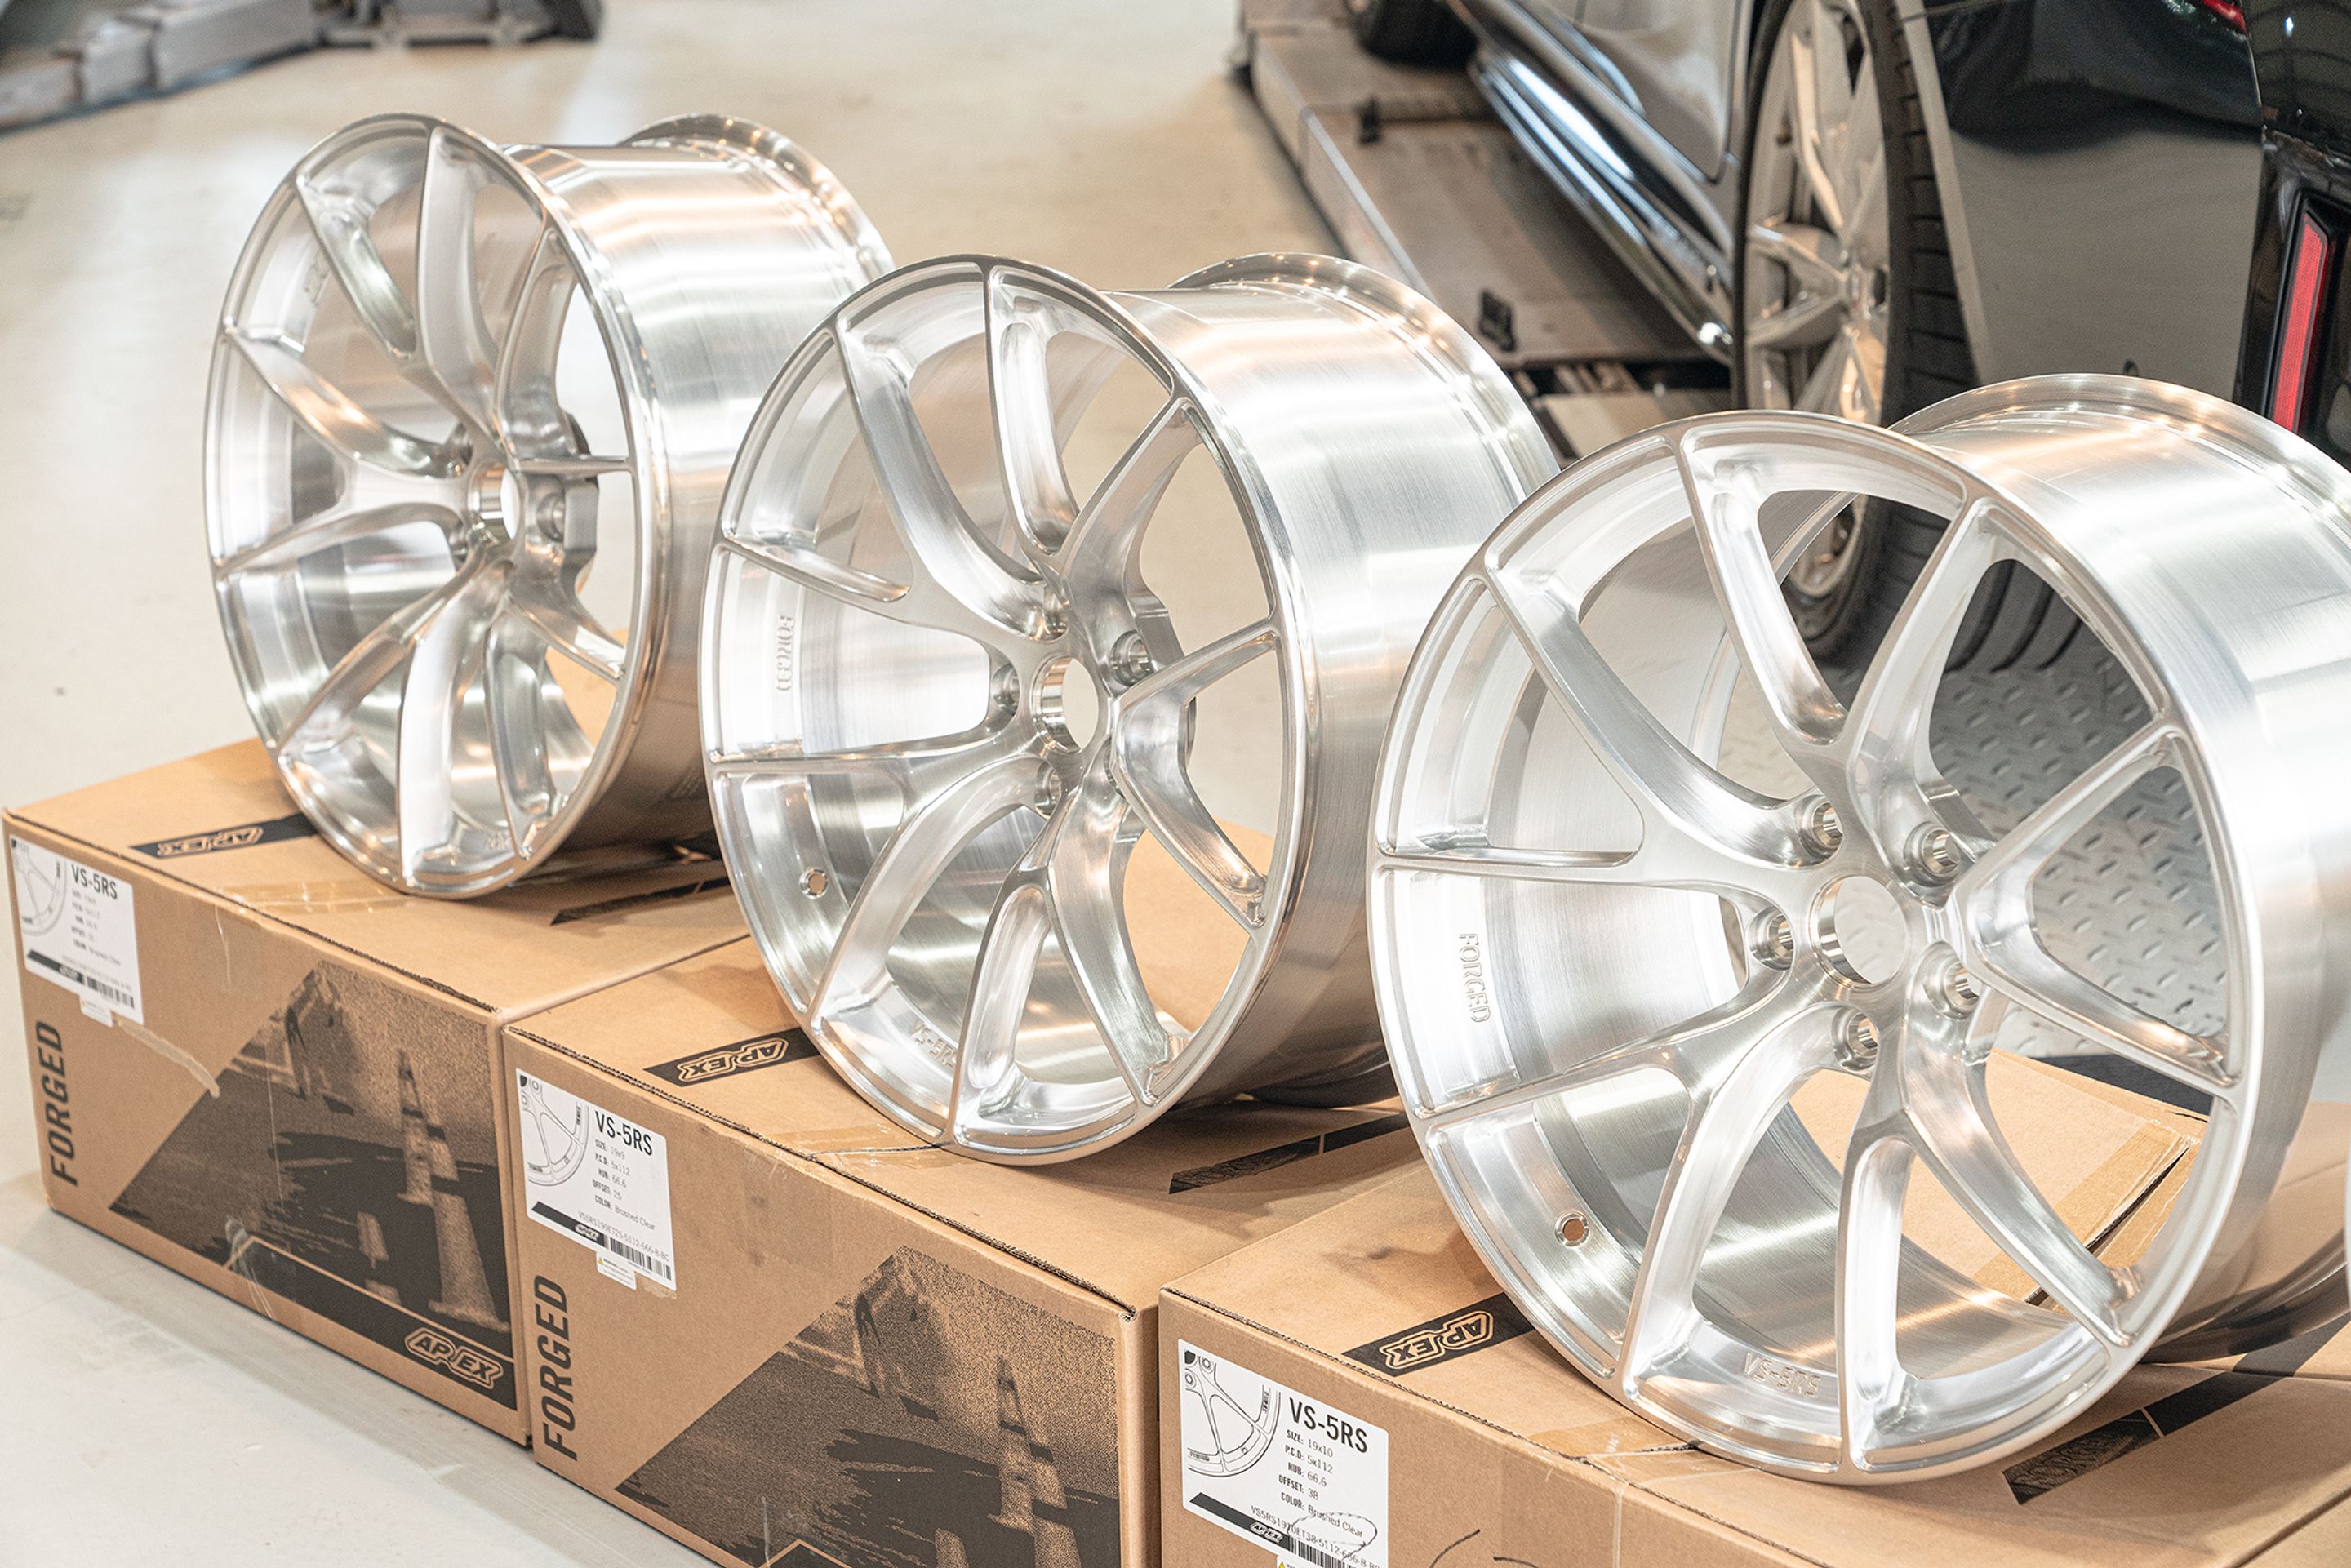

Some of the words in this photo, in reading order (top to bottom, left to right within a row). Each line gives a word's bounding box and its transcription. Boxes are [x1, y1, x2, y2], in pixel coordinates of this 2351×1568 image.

[72, 864, 118, 900] VS-5RS
[1458, 933, 1491, 1023] FORGED
[684, 1041, 784, 1078] APEX
[36, 1021, 78, 1187] FORGED
[595, 1110, 652, 1156] VS-5RS
[611, 1160, 630, 1176] 5x112
[410, 1332, 499, 1385] APEX
[1387, 1315, 1488, 1366] APEX
[534, 1275, 577, 1461] FORGED
[1744, 1352, 1821, 1398] VS-5RS
[1287, 1429, 1304, 1444] SIZE:
[1308, 1438, 1333, 1458] 19x10
[1289, 1397, 1368, 1454] VS-5RS
[1278, 1474, 1304, 1494] OFFSET:
[1308, 1488, 1319, 1500] 38
[1288, 1462, 1304, 1477] HUB:
[1307, 1471, 1327, 1487] 66.6
[1307, 1455, 1333, 1475] 5x112
[1251, 1522, 1282, 1542] APEX
[1281, 1492, 1304, 1510] COLOR:
[1308, 1504, 1340, 1528] Brushed
[1342, 1521, 1363, 1538] Clear
